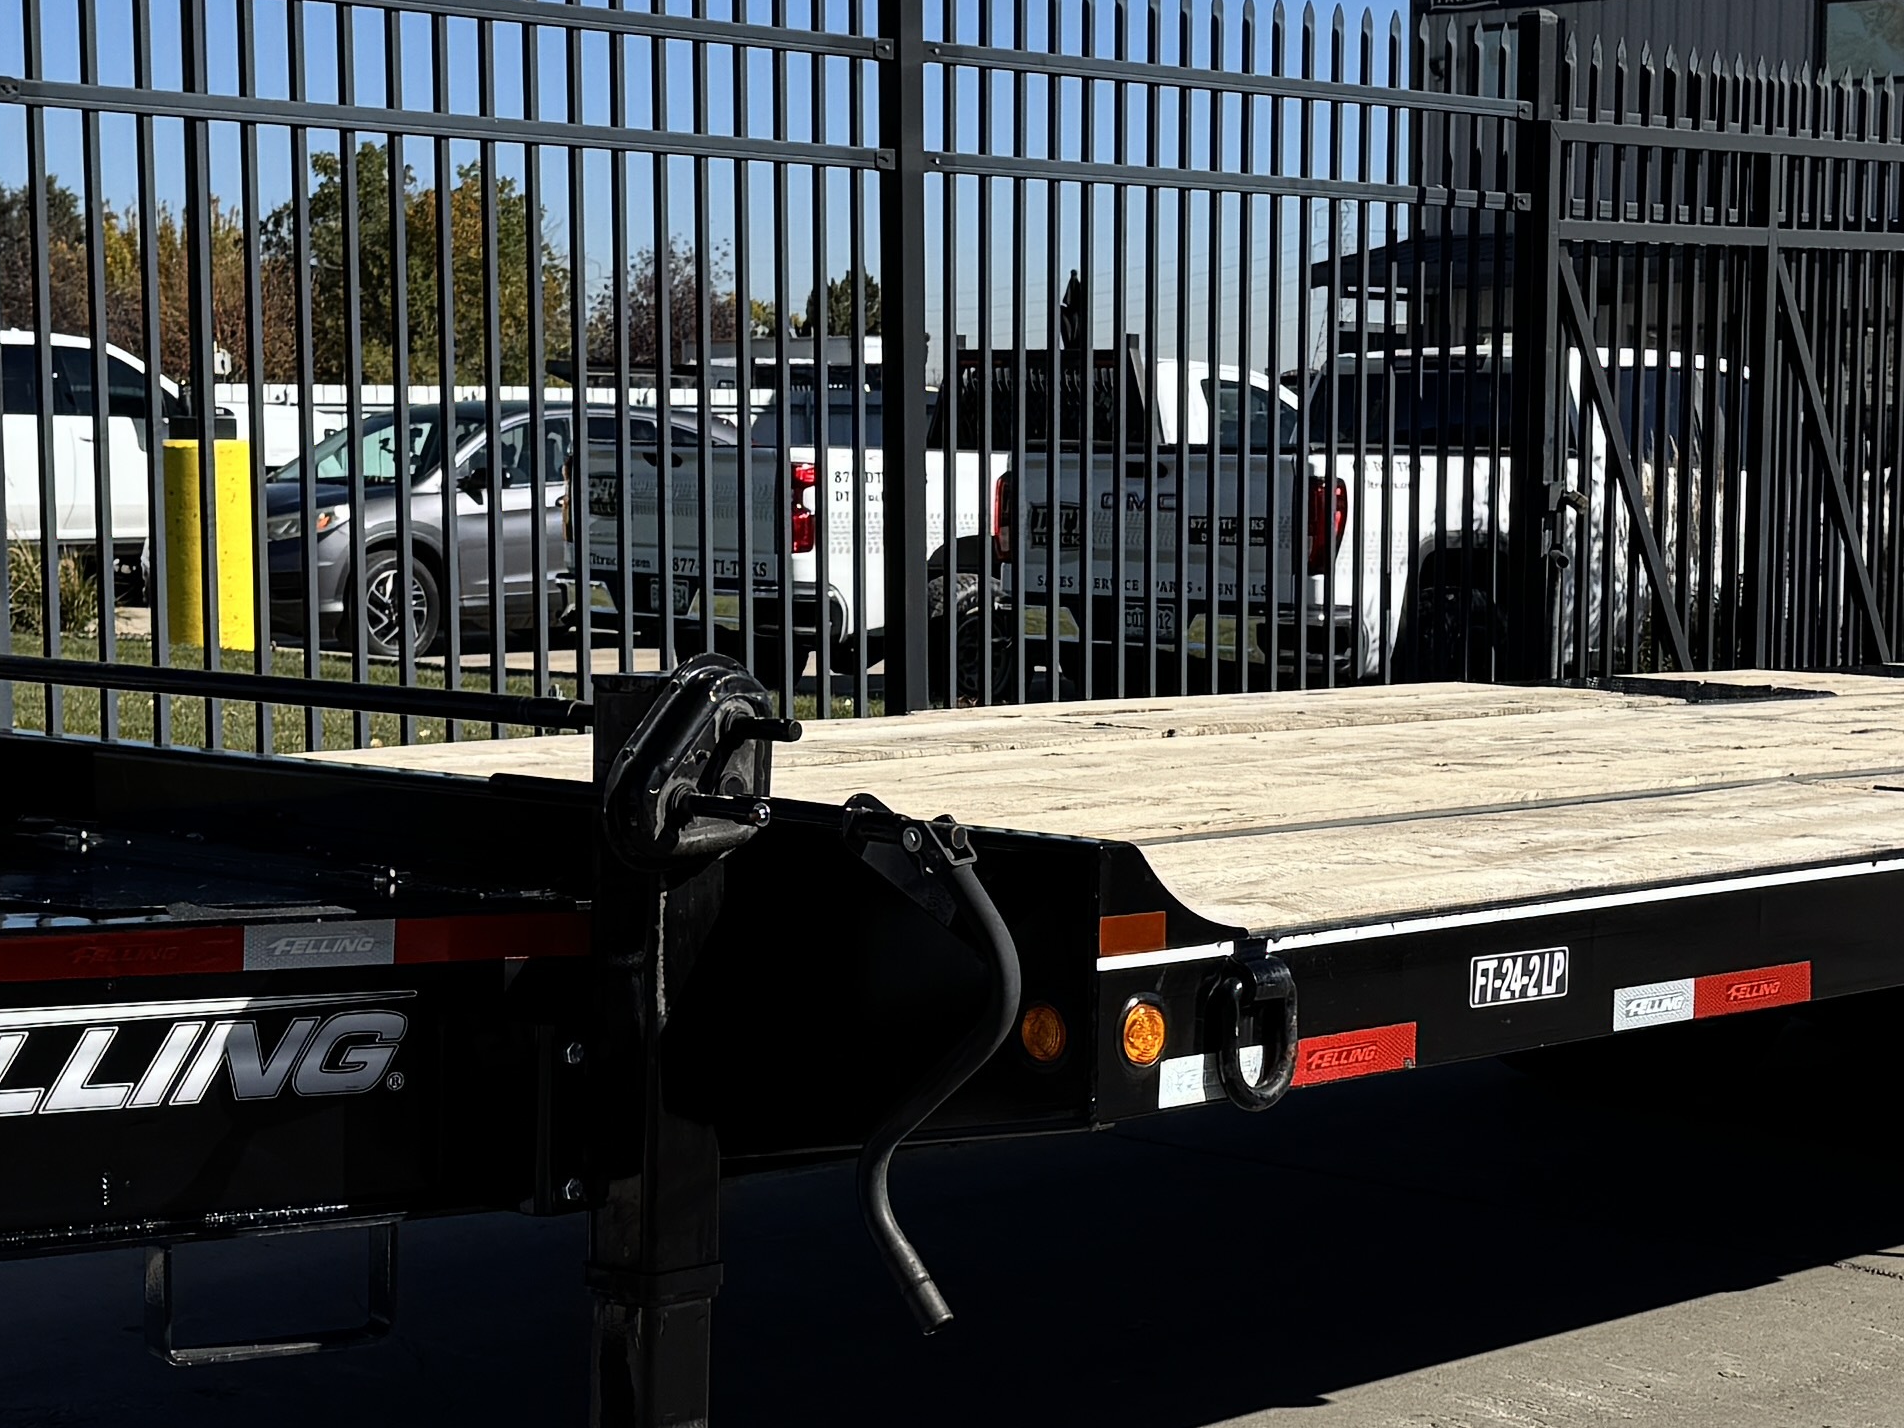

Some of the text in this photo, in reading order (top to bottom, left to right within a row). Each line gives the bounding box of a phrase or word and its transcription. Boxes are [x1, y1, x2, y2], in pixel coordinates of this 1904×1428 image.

[265, 935, 376, 956] FELLING
[1725, 977, 1782, 1000] FELLING
[1625, 992, 1686, 1018] FELLING
[1306, 1042, 1379, 1070] FELLING
